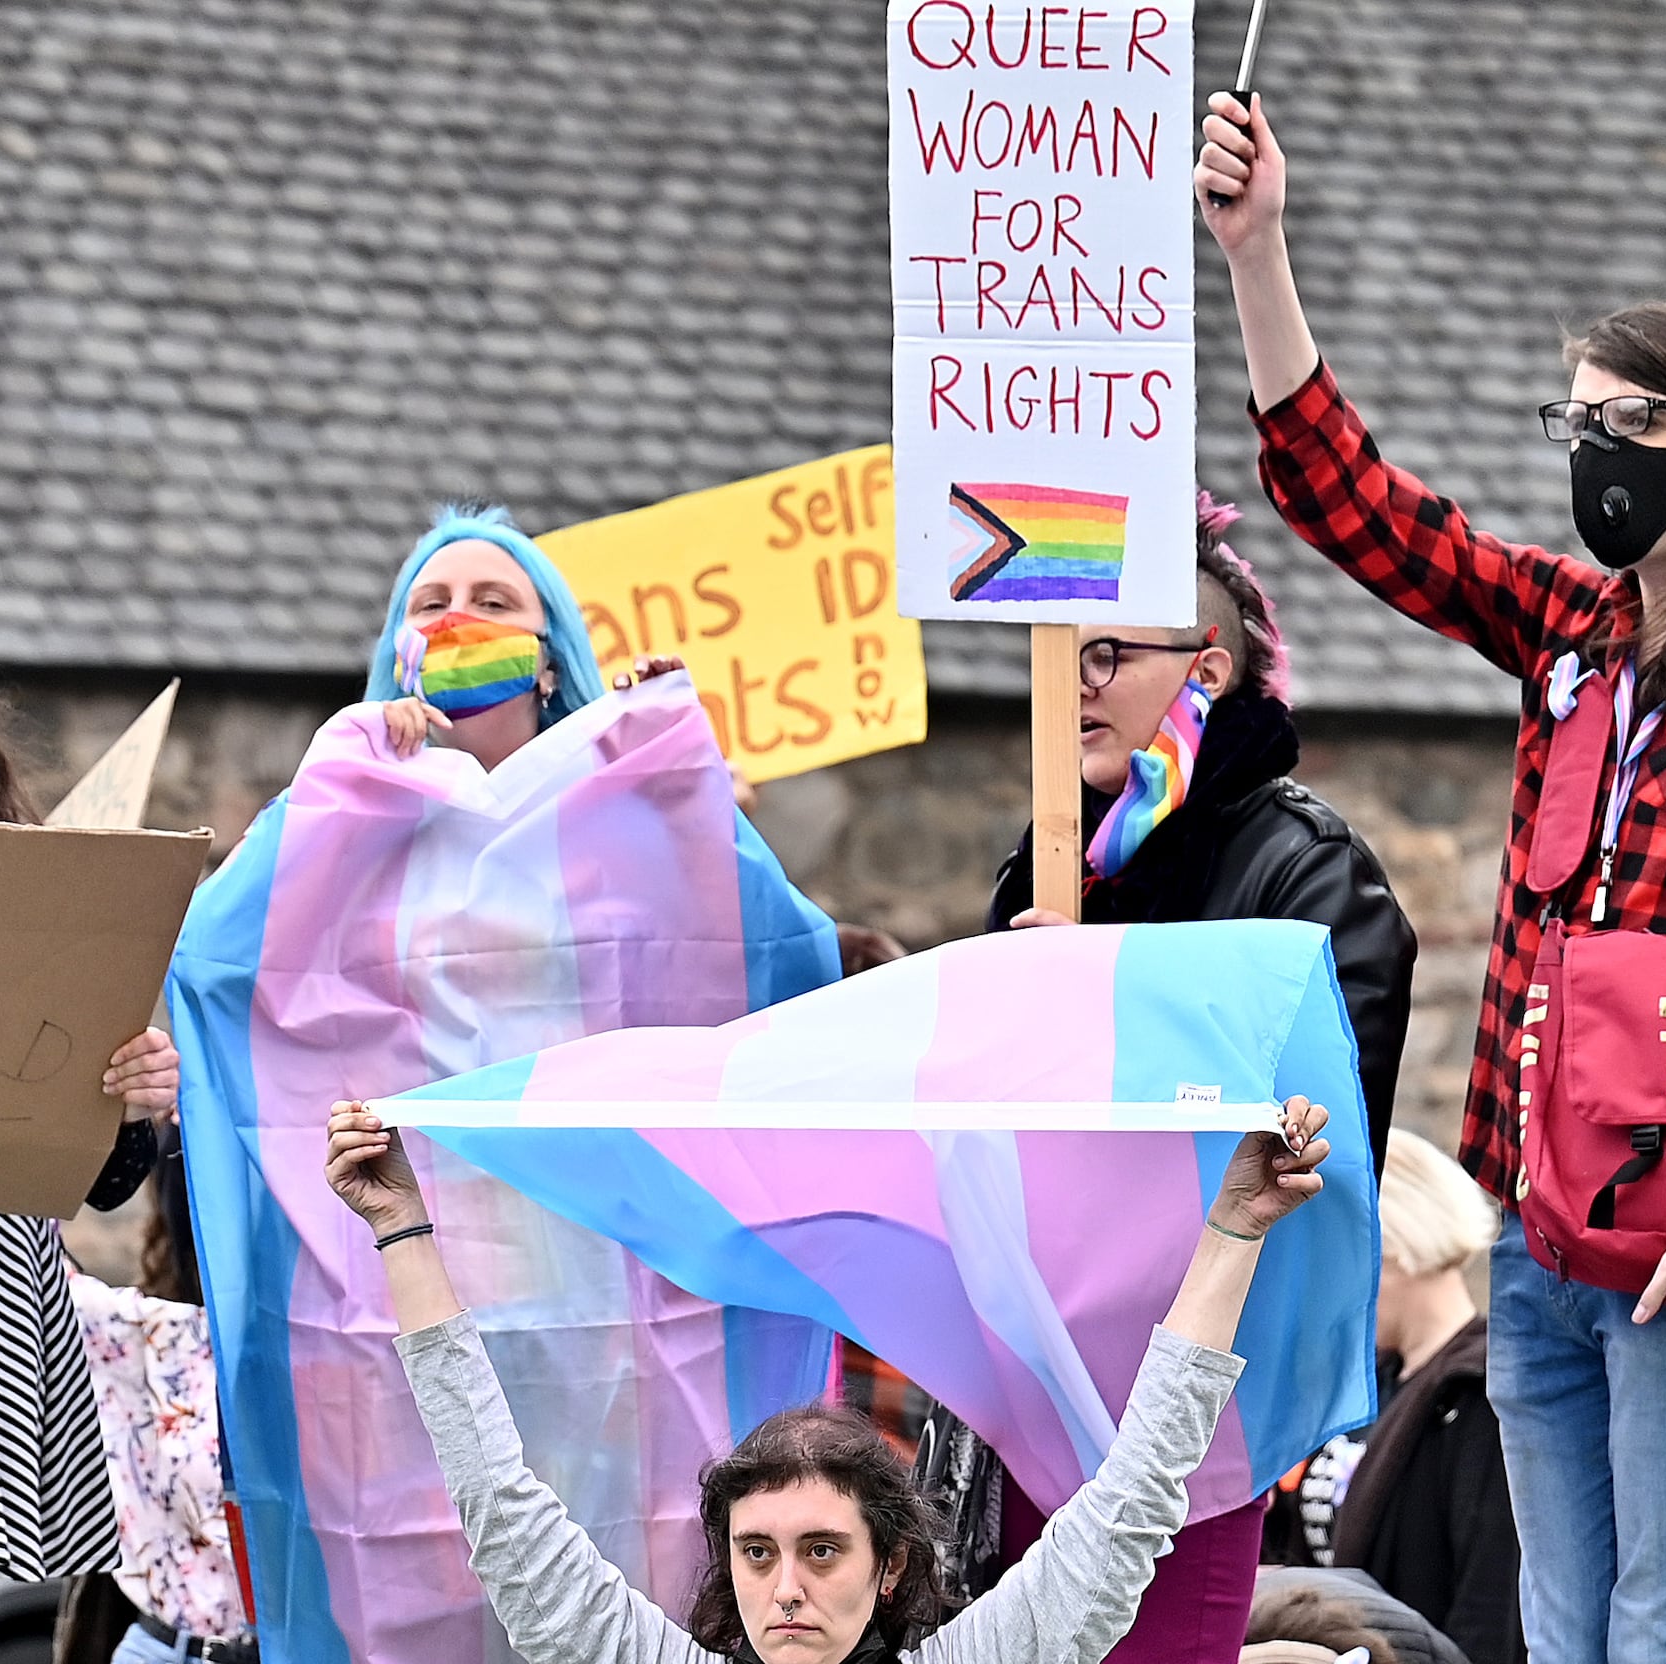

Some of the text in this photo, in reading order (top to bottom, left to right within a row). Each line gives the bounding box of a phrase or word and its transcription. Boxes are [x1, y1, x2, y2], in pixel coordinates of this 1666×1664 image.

[908, 0, 1171, 75] QUEER
[908, 88, 1157, 181] WOMAN
[971, 190, 1089, 257] FOR
[909, 256, 1167, 335] TRANS
[930, 355, 1172, 441] RIGHTS
[768, 459, 893, 550] Self
[580, 563, 741, 668] ans
[815, 549, 889, 624] ID
